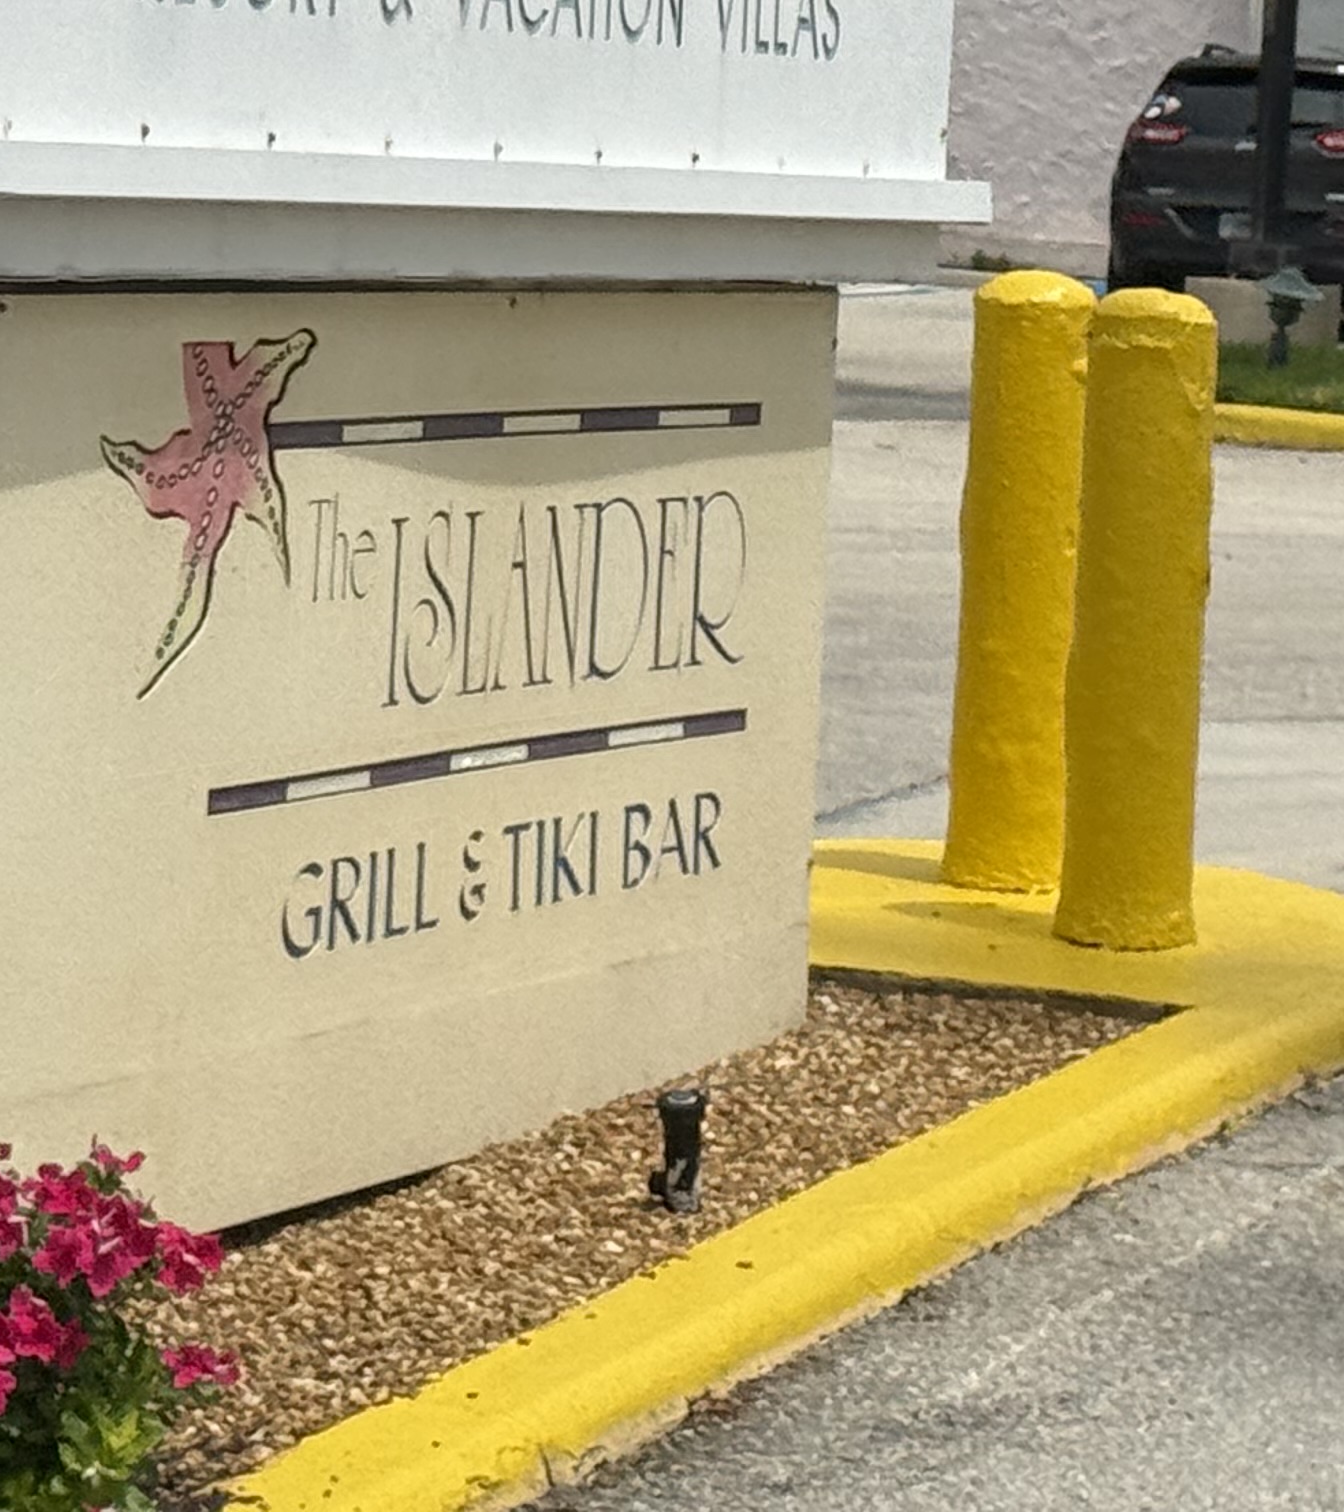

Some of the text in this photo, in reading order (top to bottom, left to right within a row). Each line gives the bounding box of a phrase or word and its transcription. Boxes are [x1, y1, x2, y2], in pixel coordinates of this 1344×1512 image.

[308, 490, 748, 707] The ISLANDER
[281, 791, 723, 960] GRILL & TIKI BAR
